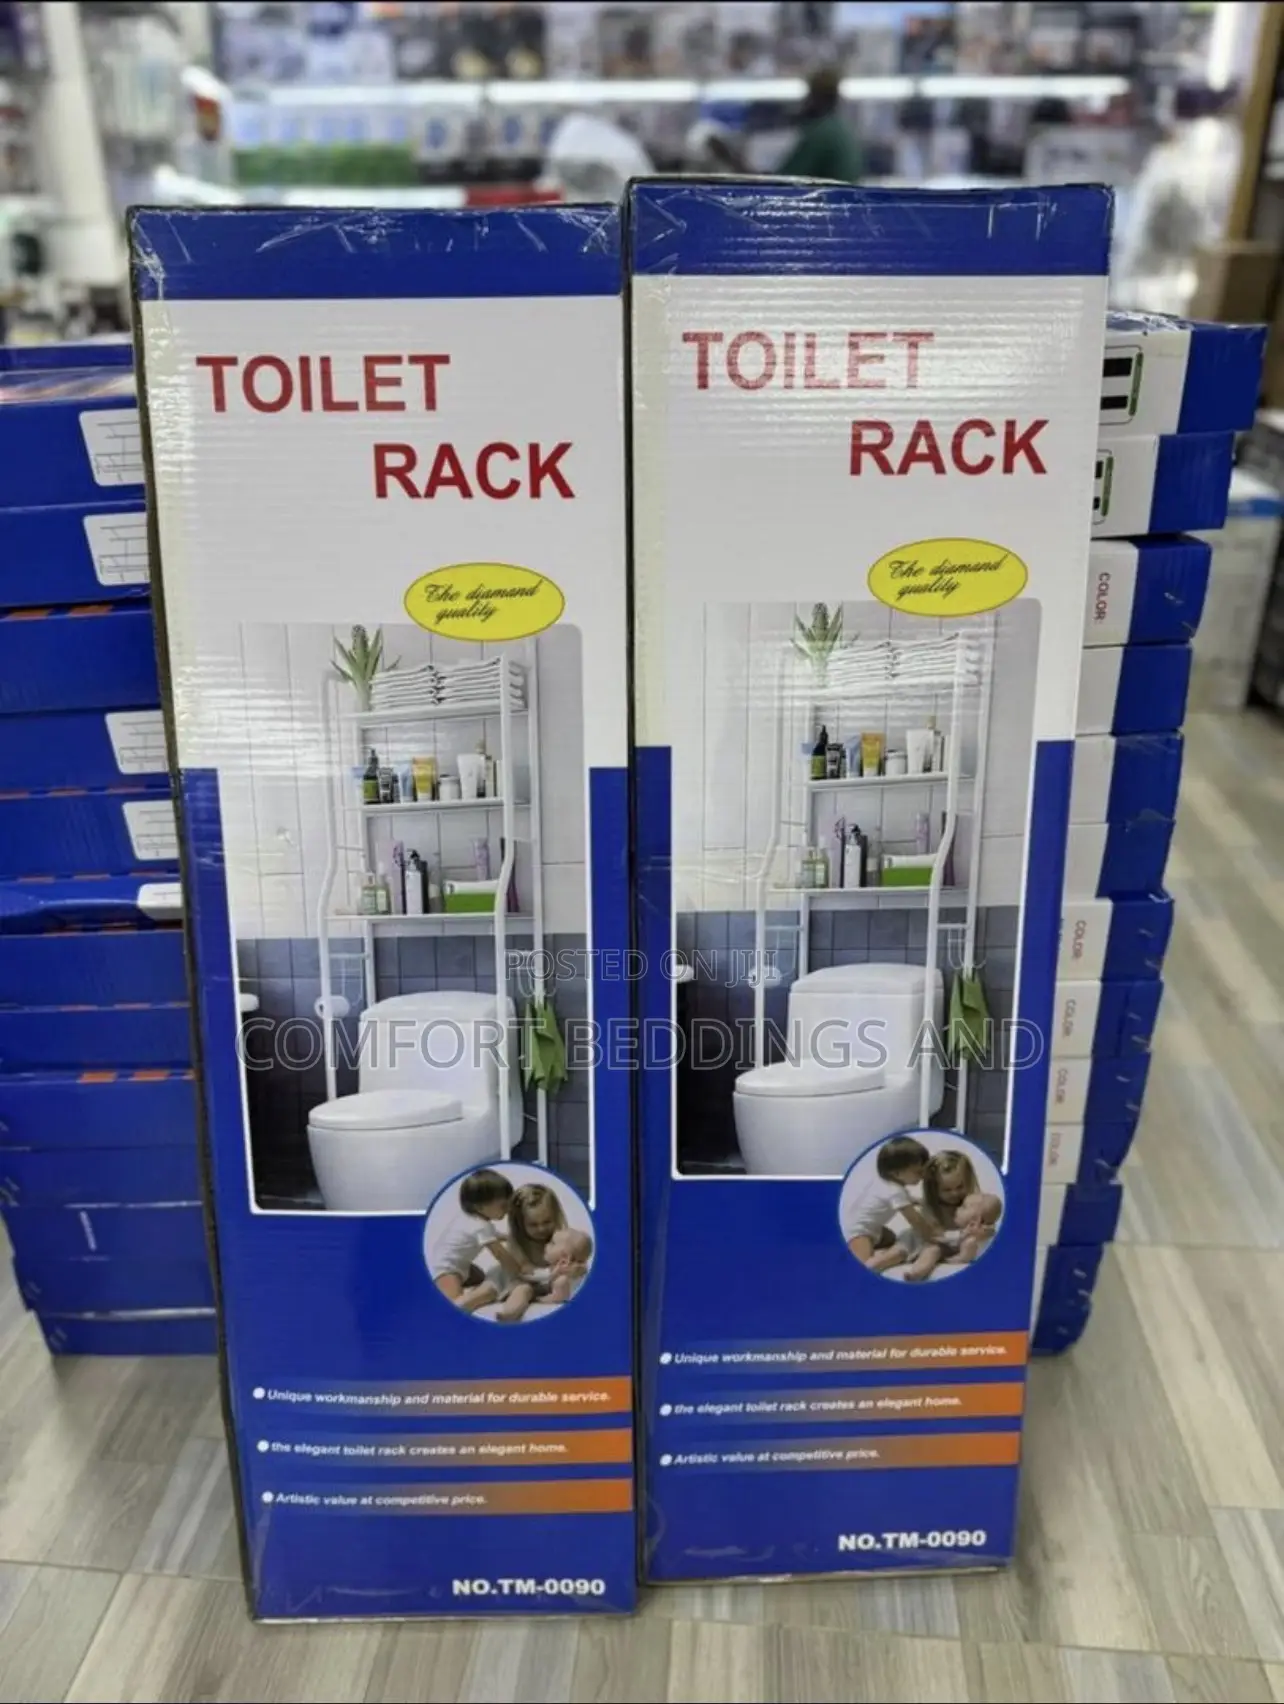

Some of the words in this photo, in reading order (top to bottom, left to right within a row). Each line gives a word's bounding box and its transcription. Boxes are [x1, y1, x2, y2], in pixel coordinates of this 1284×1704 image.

[682, 331, 934, 390] TOILET
[196, 354, 450, 413] TOILET
[849, 419, 1049, 476] RACK
[373, 442, 575, 500] RACK
[889, 560, 925, 579] The
[425, 584, 460, 602] The
[896, 576, 961, 602] quality
[435, 600, 499, 625] quality
[674, 1353, 719, 1366] Unique
[722, 1350, 807, 1363] workmanship
[809, 1350, 834, 1361] and
[836, 1348, 887, 1360] material
[890, 1348, 907, 1359] for
[909, 1346, 957, 1357] durable
[960, 1345, 1007, 1356] service.
[267, 1389, 312, 1403] Unique
[315, 1392, 401, 1407] workmanship
[404, 1394, 430, 1404] and
[432, 1392, 485, 1404] material
[487, 1392, 507, 1403] for
[509, 1391, 558, 1403] durable
[561, 1391, 611, 1402] service.
[674, 1404, 694, 1414] the
[697, 1402, 743, 1415] elegant
[745, 1401, 778, 1412] toilet
[780, 1400, 806, 1411] rack
[810, 1399, 854, 1410] creates
[858, 1400, 874, 1409] an
[877, 1397, 922, 1410] elegant
[925, 1396, 962, 1406] home.
[271, 1442, 291, 1452] the
[294, 1443, 340, 1456] elegant
[343, 1445, 376, 1455] toilet
[378, 1445, 405, 1455] rack
[409, 1445, 456, 1455] creates
[459, 1446, 475, 1454] an
[478, 1443, 526, 1456] elegant
[529, 1442, 568, 1453] home.
[674, 1453, 718, 1465] Artistic
[722, 1452, 754, 1463] value
[757, 1451, 771, 1462] at
[772, 1449, 843, 1462] competitive
[845, 1448, 880, 1462] price.
[276, 1493, 321, 1505] Artistic
[324, 1496, 357, 1505] value
[360, 1495, 373, 1505] at
[375, 1494, 449, 1507] competitive
[451, 1494, 488, 1506] price.
[838, 1529, 987, 1551] NO.TM-0090
[452, 1578, 606, 1595] NO.TM-0090
